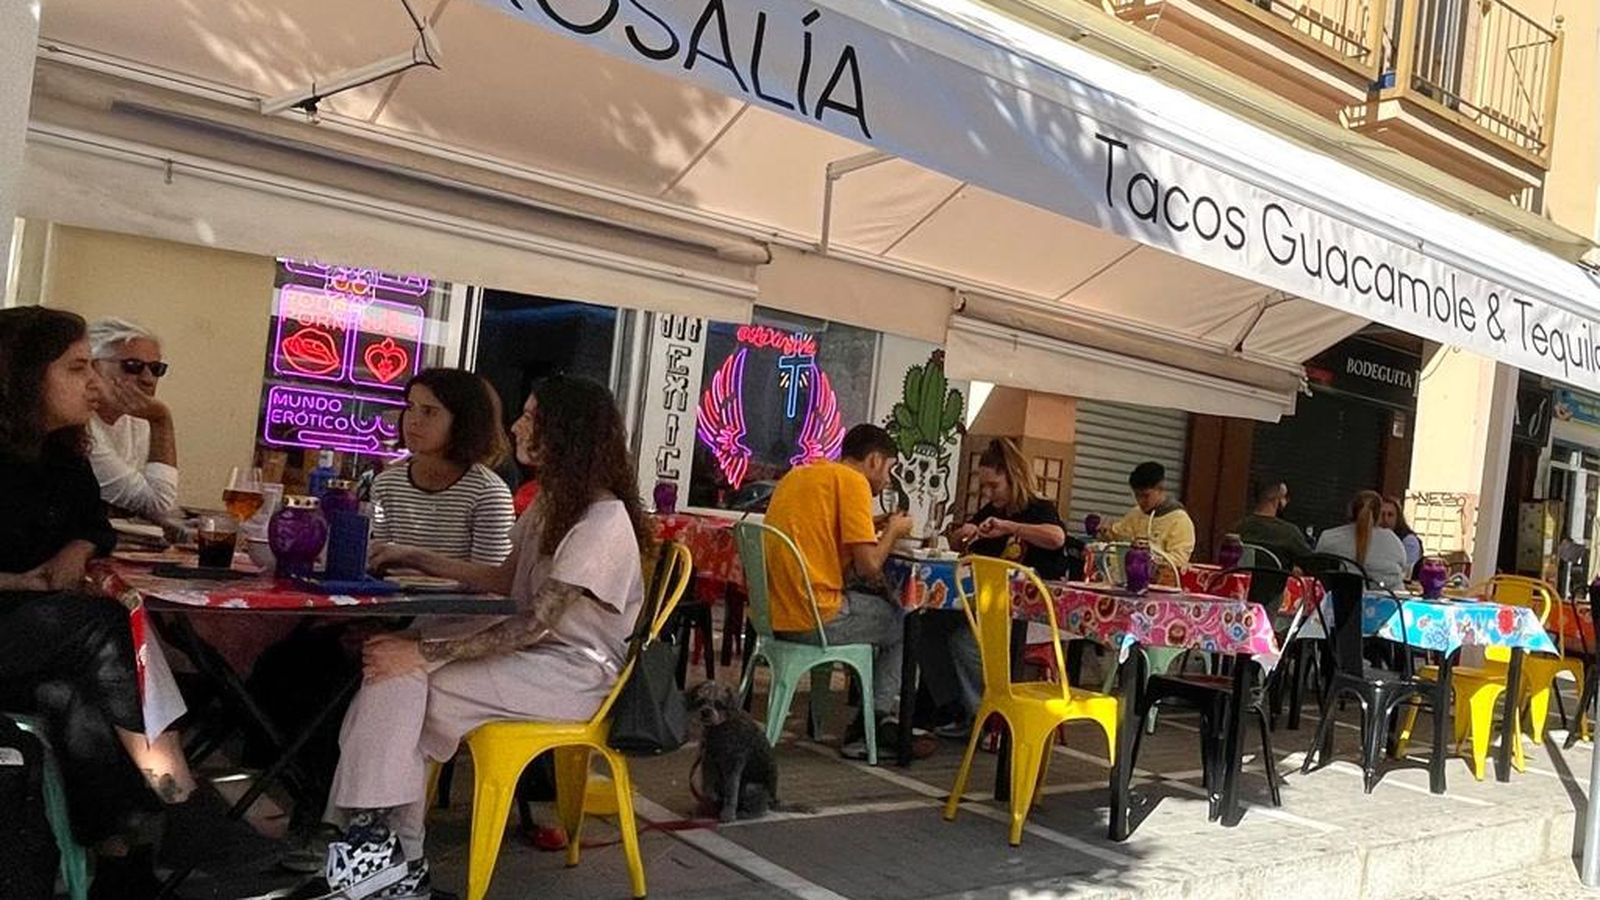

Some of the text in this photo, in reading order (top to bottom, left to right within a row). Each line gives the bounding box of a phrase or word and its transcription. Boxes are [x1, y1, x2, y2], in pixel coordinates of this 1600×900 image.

[1095, 133, 1246, 250] Tacos
[1262, 203, 1476, 332] Guacamole
[1487, 292, 1507, 343] &
[1346, 357, 1412, 388] BODEGUITA
[273, 393, 342, 412] MUNDO
[271, 409, 349, 431] ERÓTICO
